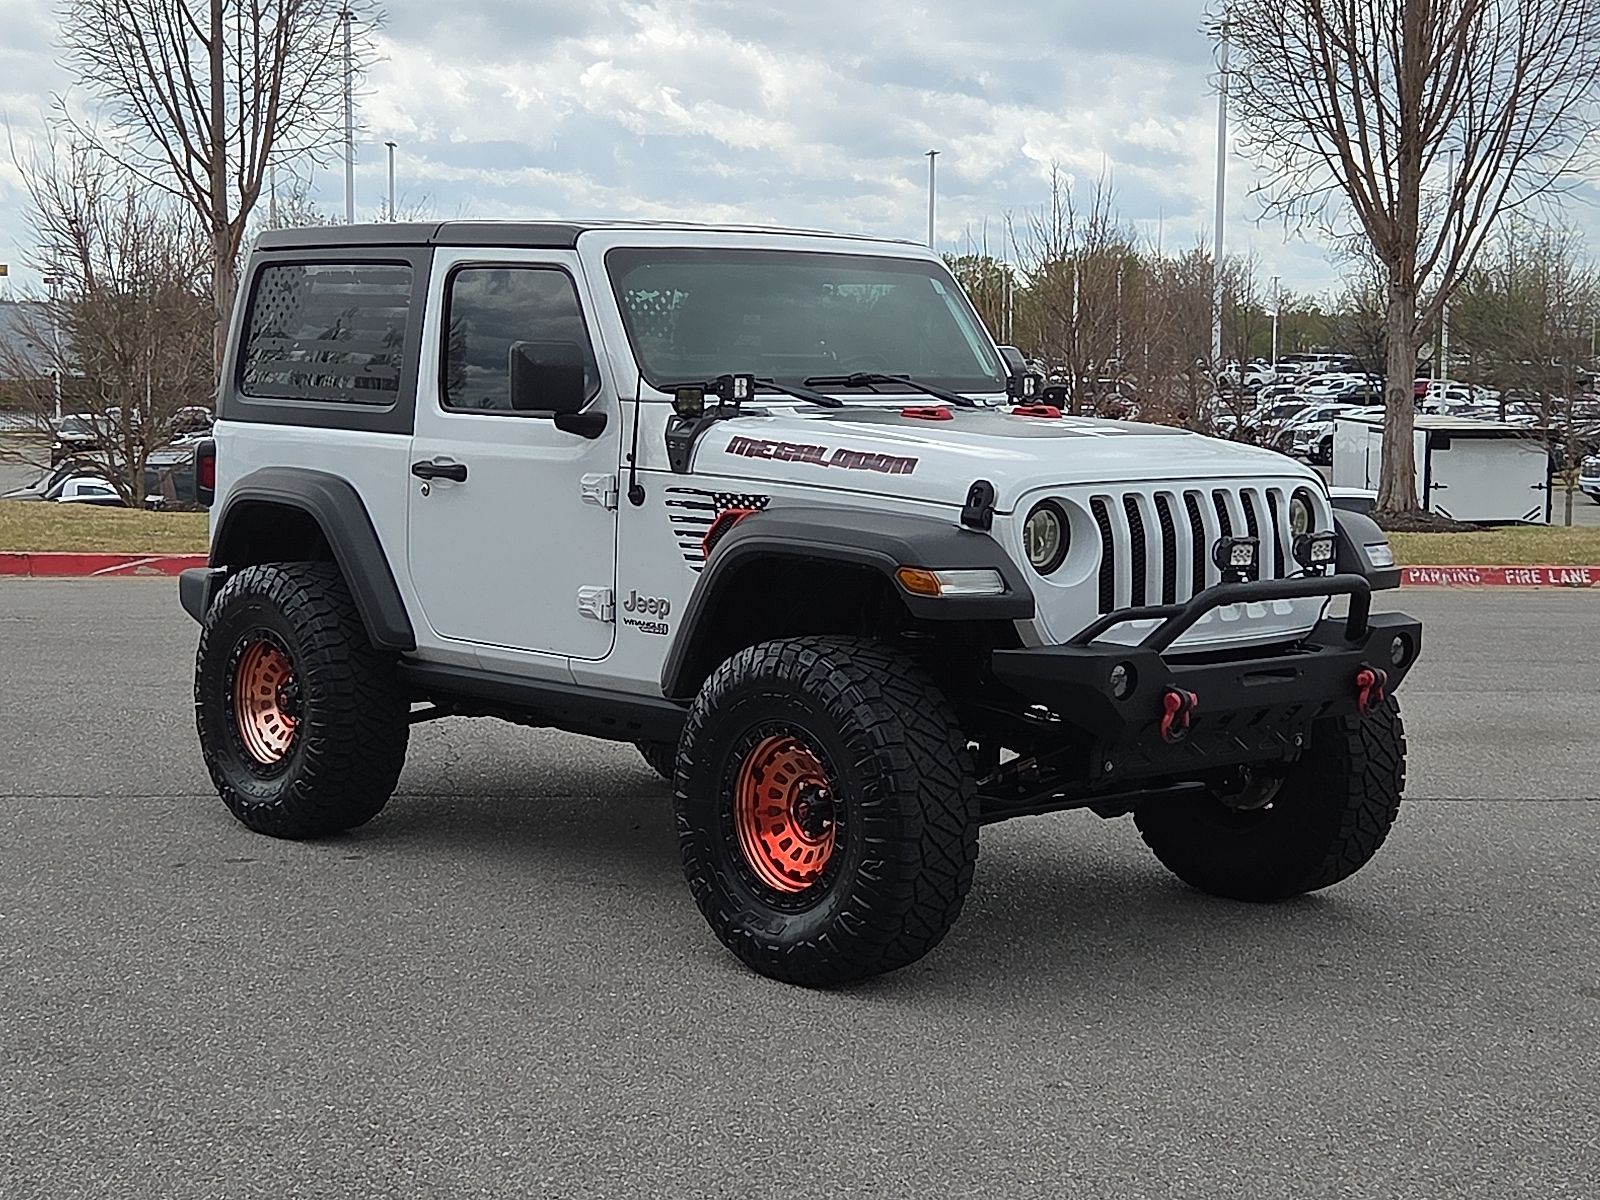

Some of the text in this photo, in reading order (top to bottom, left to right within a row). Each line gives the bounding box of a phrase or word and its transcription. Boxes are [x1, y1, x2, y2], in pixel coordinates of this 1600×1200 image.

[1505, 569, 1542, 583] FIRE
[1548, 569, 1591, 583] LANE
[623, 590, 670, 619] Jeep
